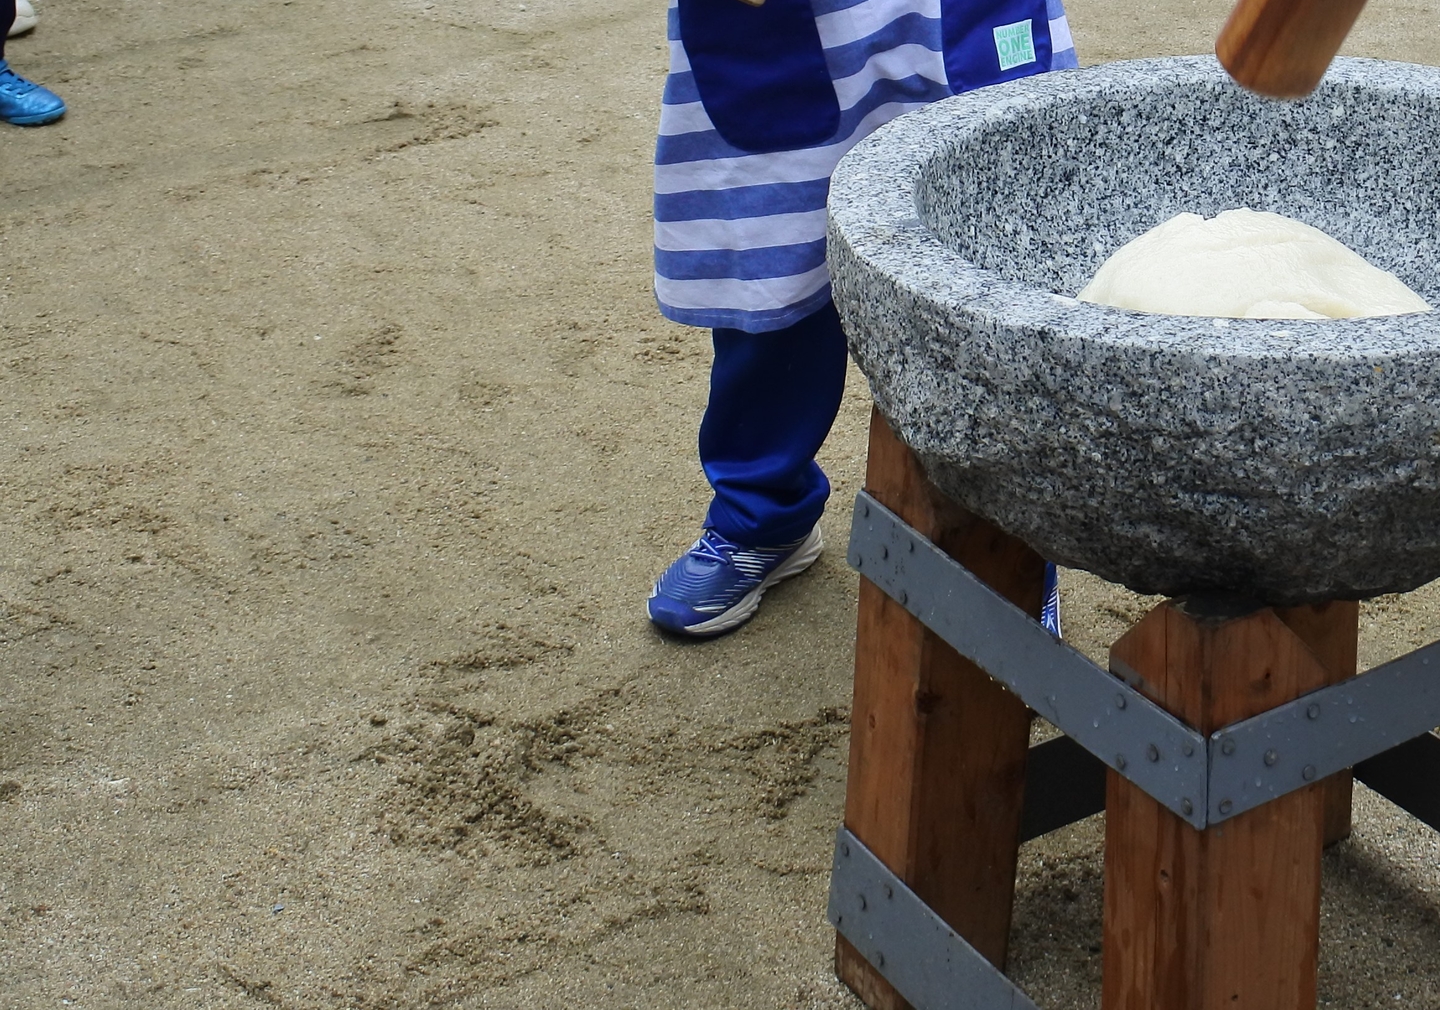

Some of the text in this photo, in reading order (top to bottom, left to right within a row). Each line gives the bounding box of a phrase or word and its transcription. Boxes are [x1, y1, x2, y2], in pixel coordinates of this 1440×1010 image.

[996, 24, 1029, 39] NUMBER
[999, 33, 1031, 56] ONE
[1001, 51, 1032, 67] ENGINE
